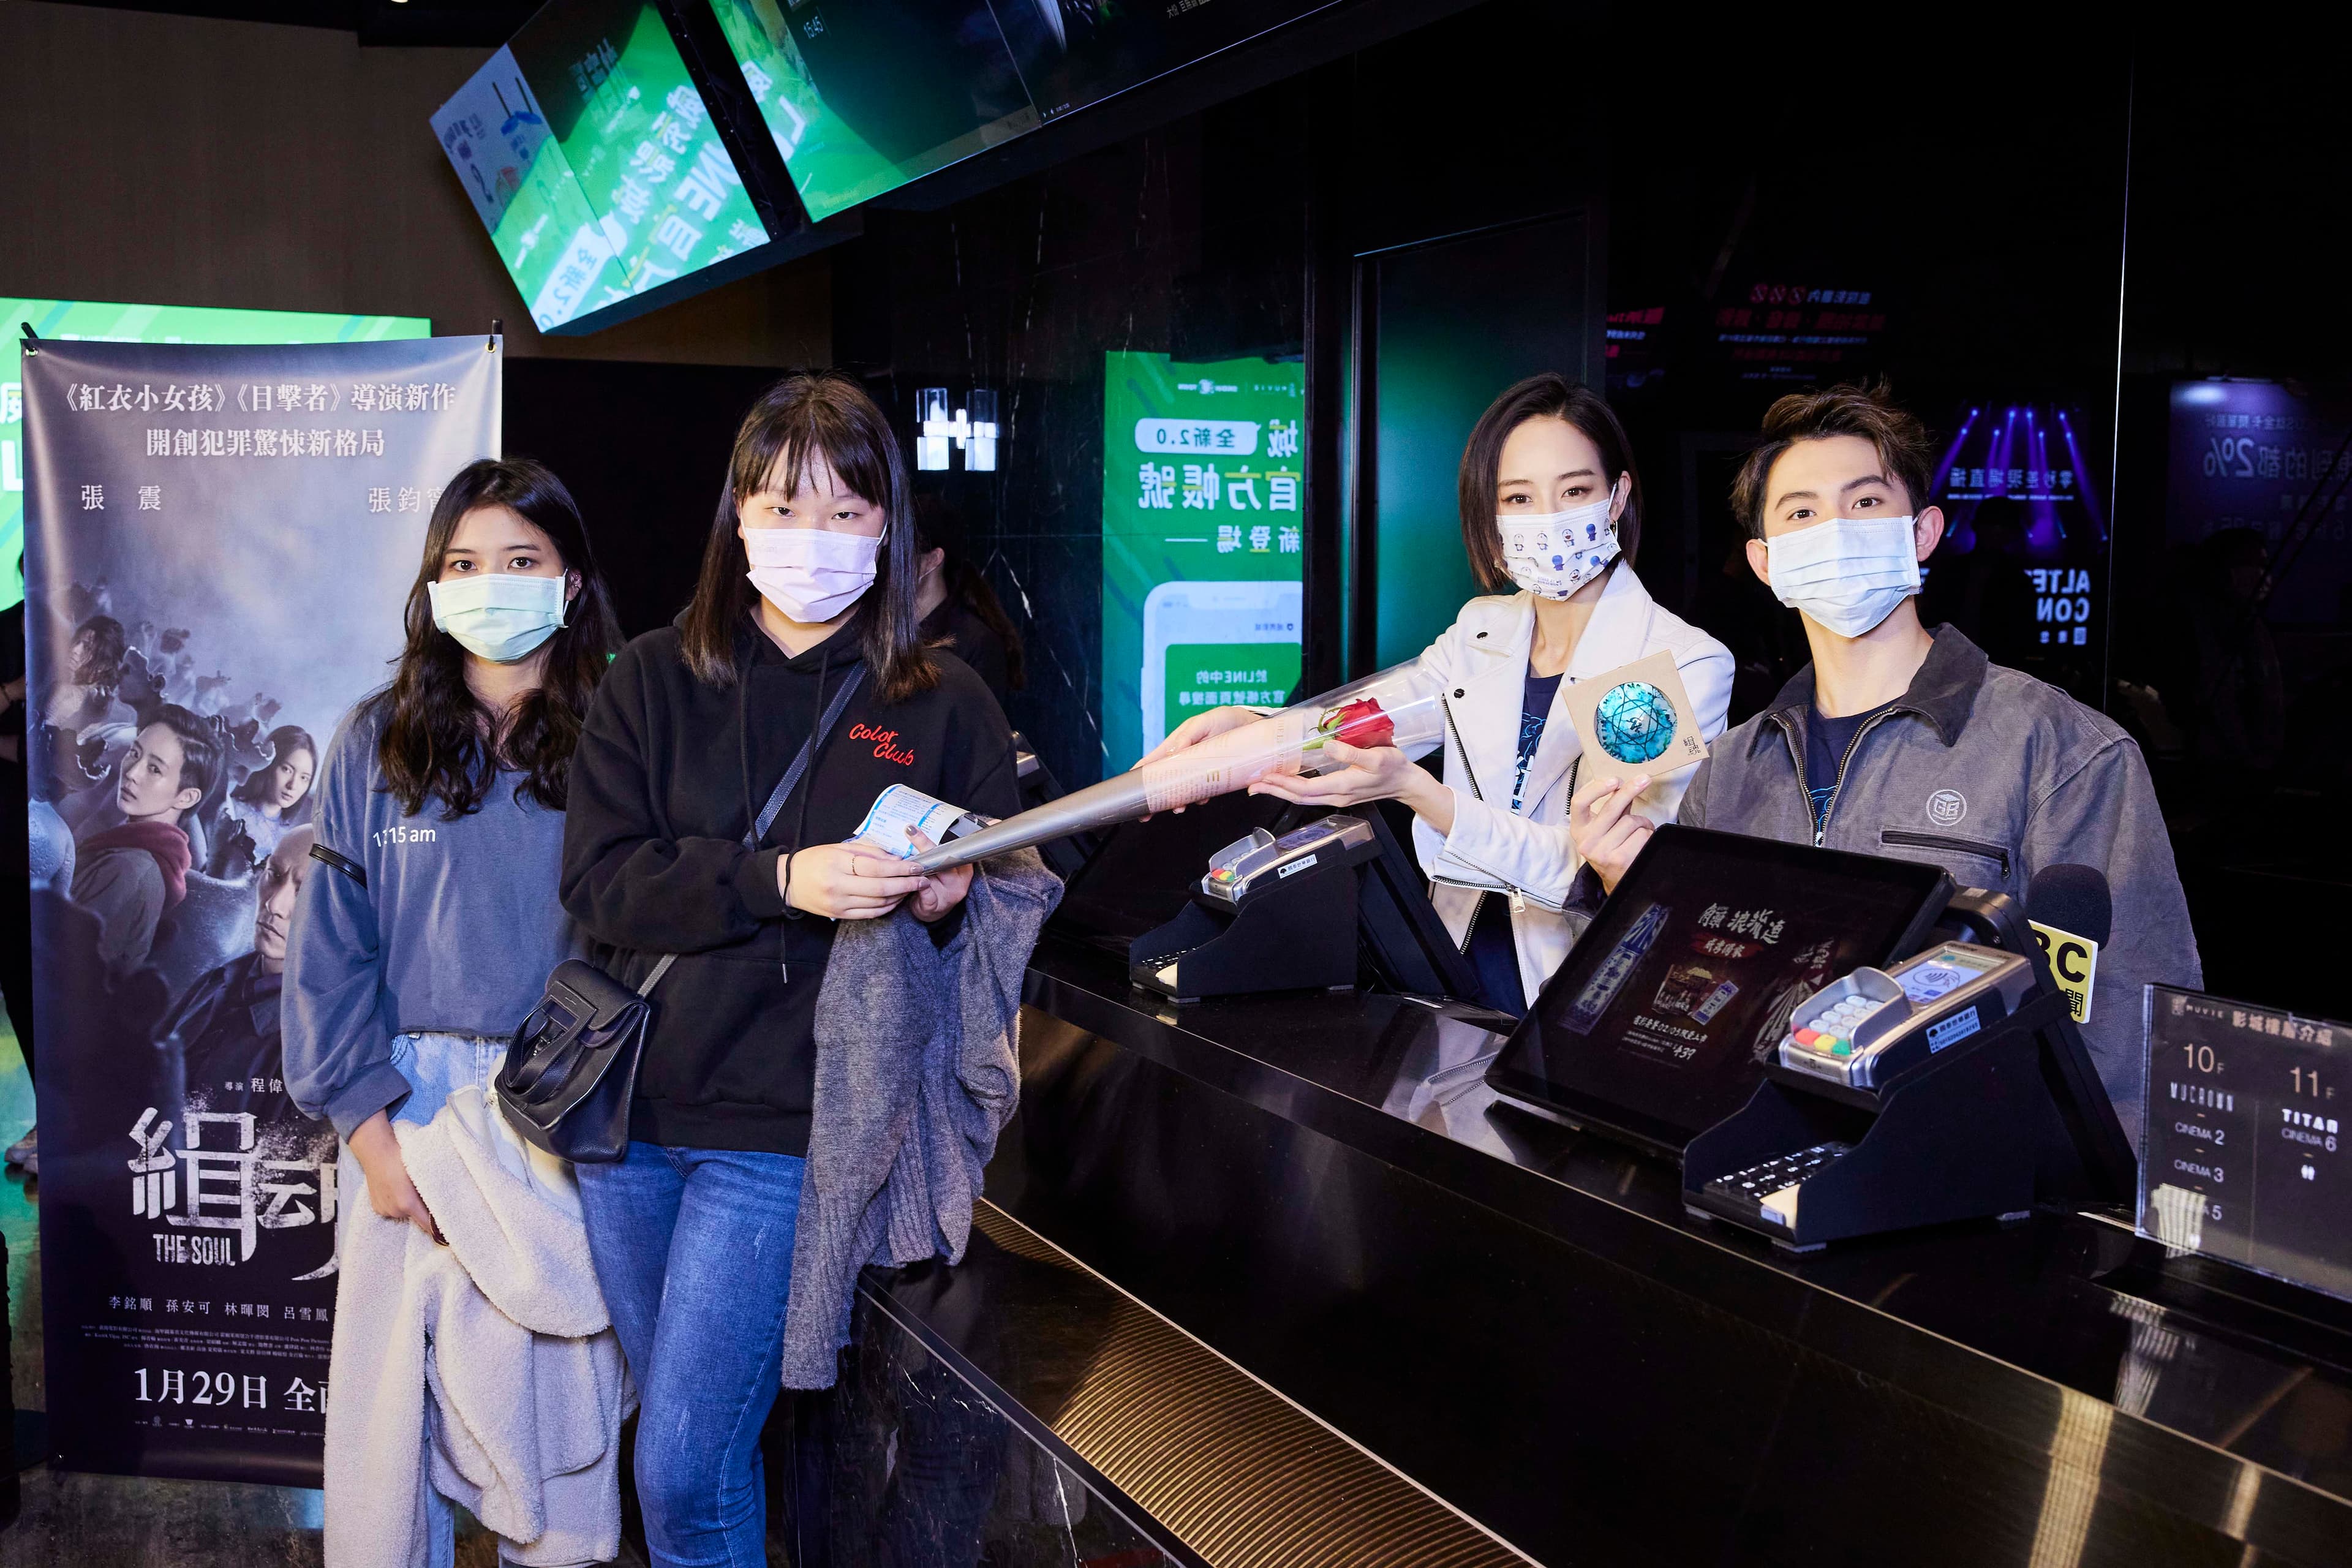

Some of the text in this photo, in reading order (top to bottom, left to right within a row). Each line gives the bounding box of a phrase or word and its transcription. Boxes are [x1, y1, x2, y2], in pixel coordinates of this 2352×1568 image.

[803, 16, 824, 39] 15:45
[146, 428, 385, 458] 開創犯罪驚悚新格局
[849, 723, 899, 742] Color
[873, 742, 914, 766] Club
[2282, 1109, 2338, 1133] TITAN
[2174, 1122, 2225, 1145] CINEMA 2
[2282, 1128, 2337, 1152] CINEMA 6
[2174, 1159, 2224, 1183] CINEMA 3
[2211, 1205, 2223, 1221] 5
[153, 1234, 236, 1267] THE SOUL
[108, 1295, 153, 1311] 李銘順
[165, 1298, 211, 1316] 孫安可
[284, 1306, 329, 1322] 呂雪鳳
[134, 1369, 268, 1410] 1月29日
